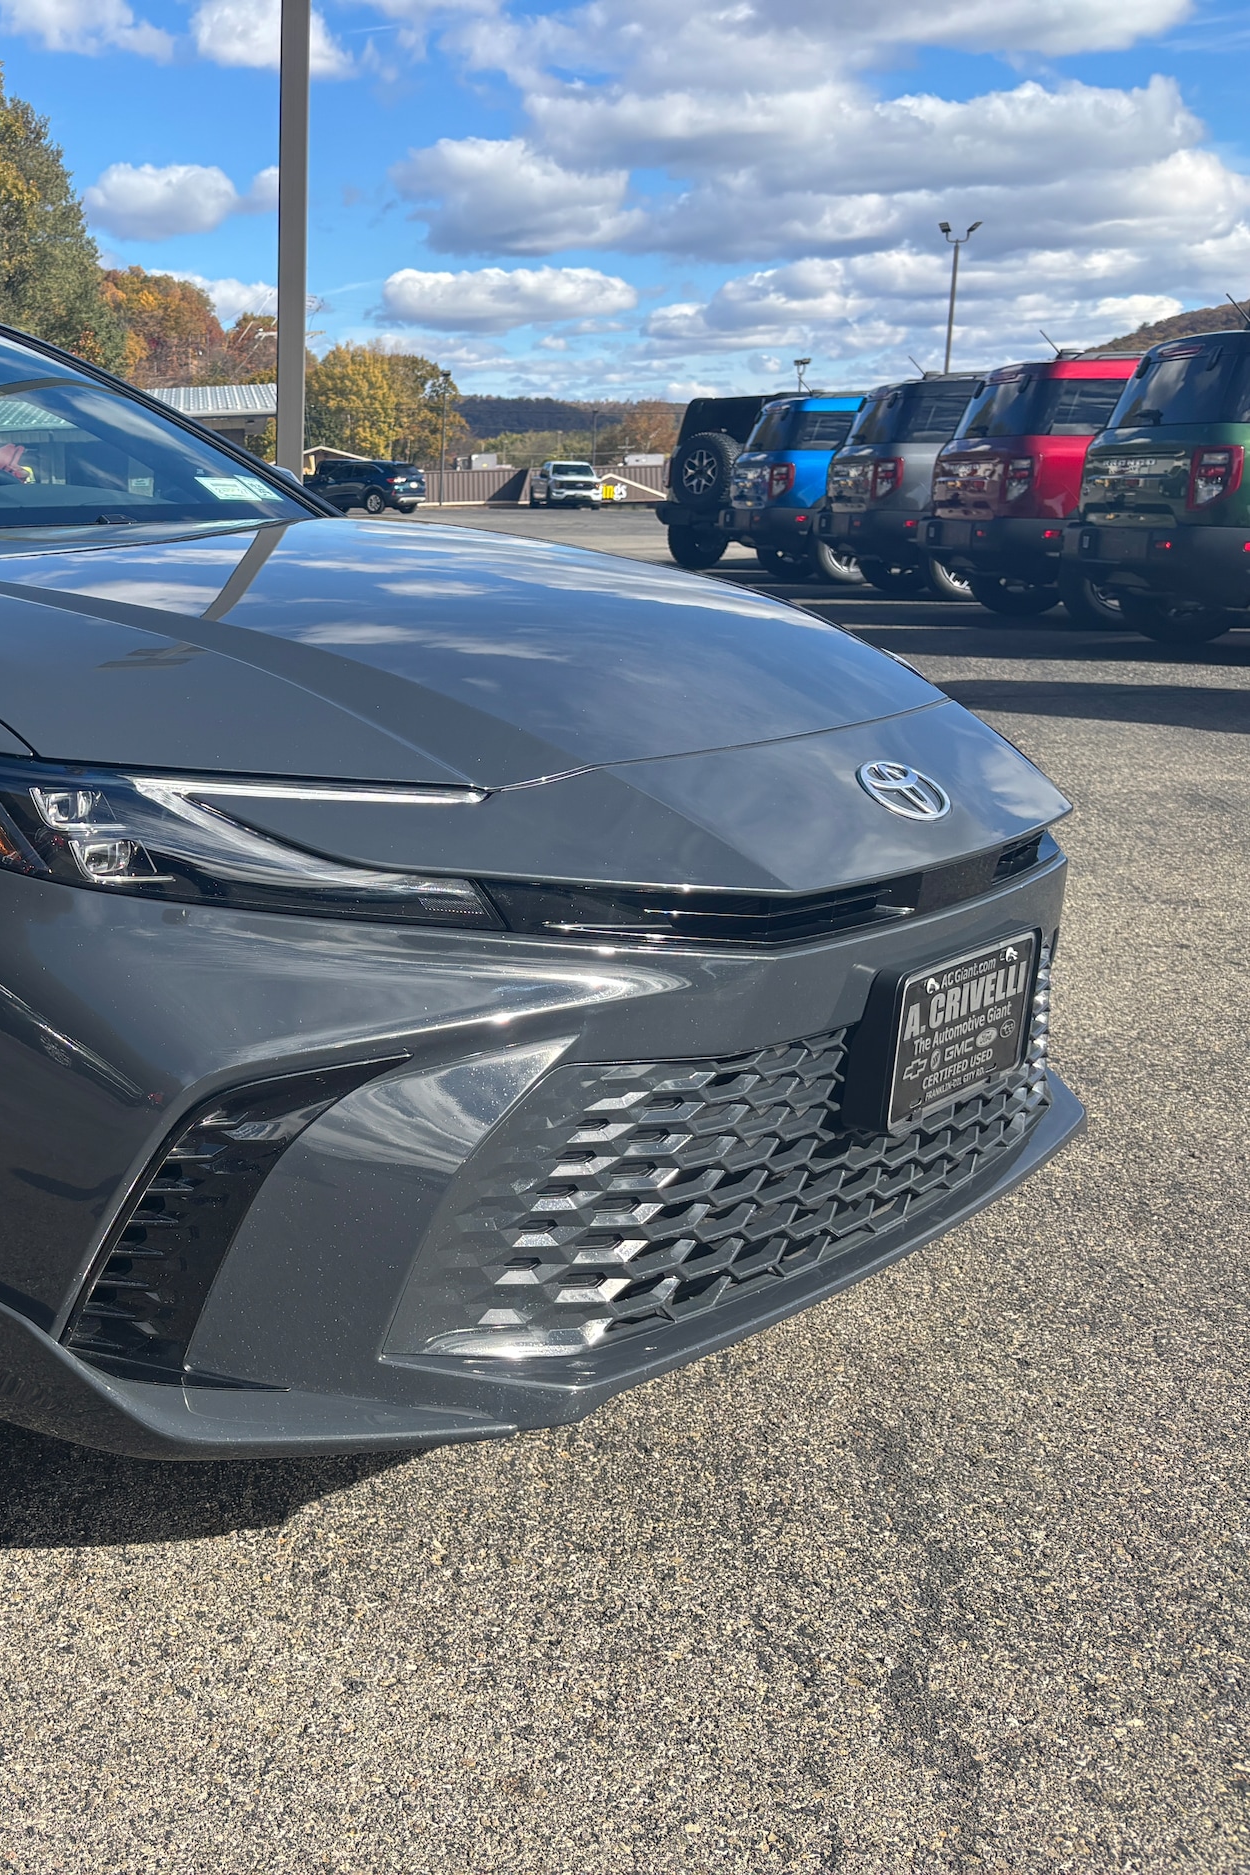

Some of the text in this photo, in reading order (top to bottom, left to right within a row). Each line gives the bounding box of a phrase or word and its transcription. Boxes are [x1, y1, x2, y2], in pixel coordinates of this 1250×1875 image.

[903, 960, 1028, 1042] A. CRIVELLI
[913, 1001, 1012, 1056] The Automotive Giant
[944, 1036, 975, 1062] GMC
[922, 1048, 994, 1090] CERTIFIED USED
[962, 1070, 976, 1083] CITY
